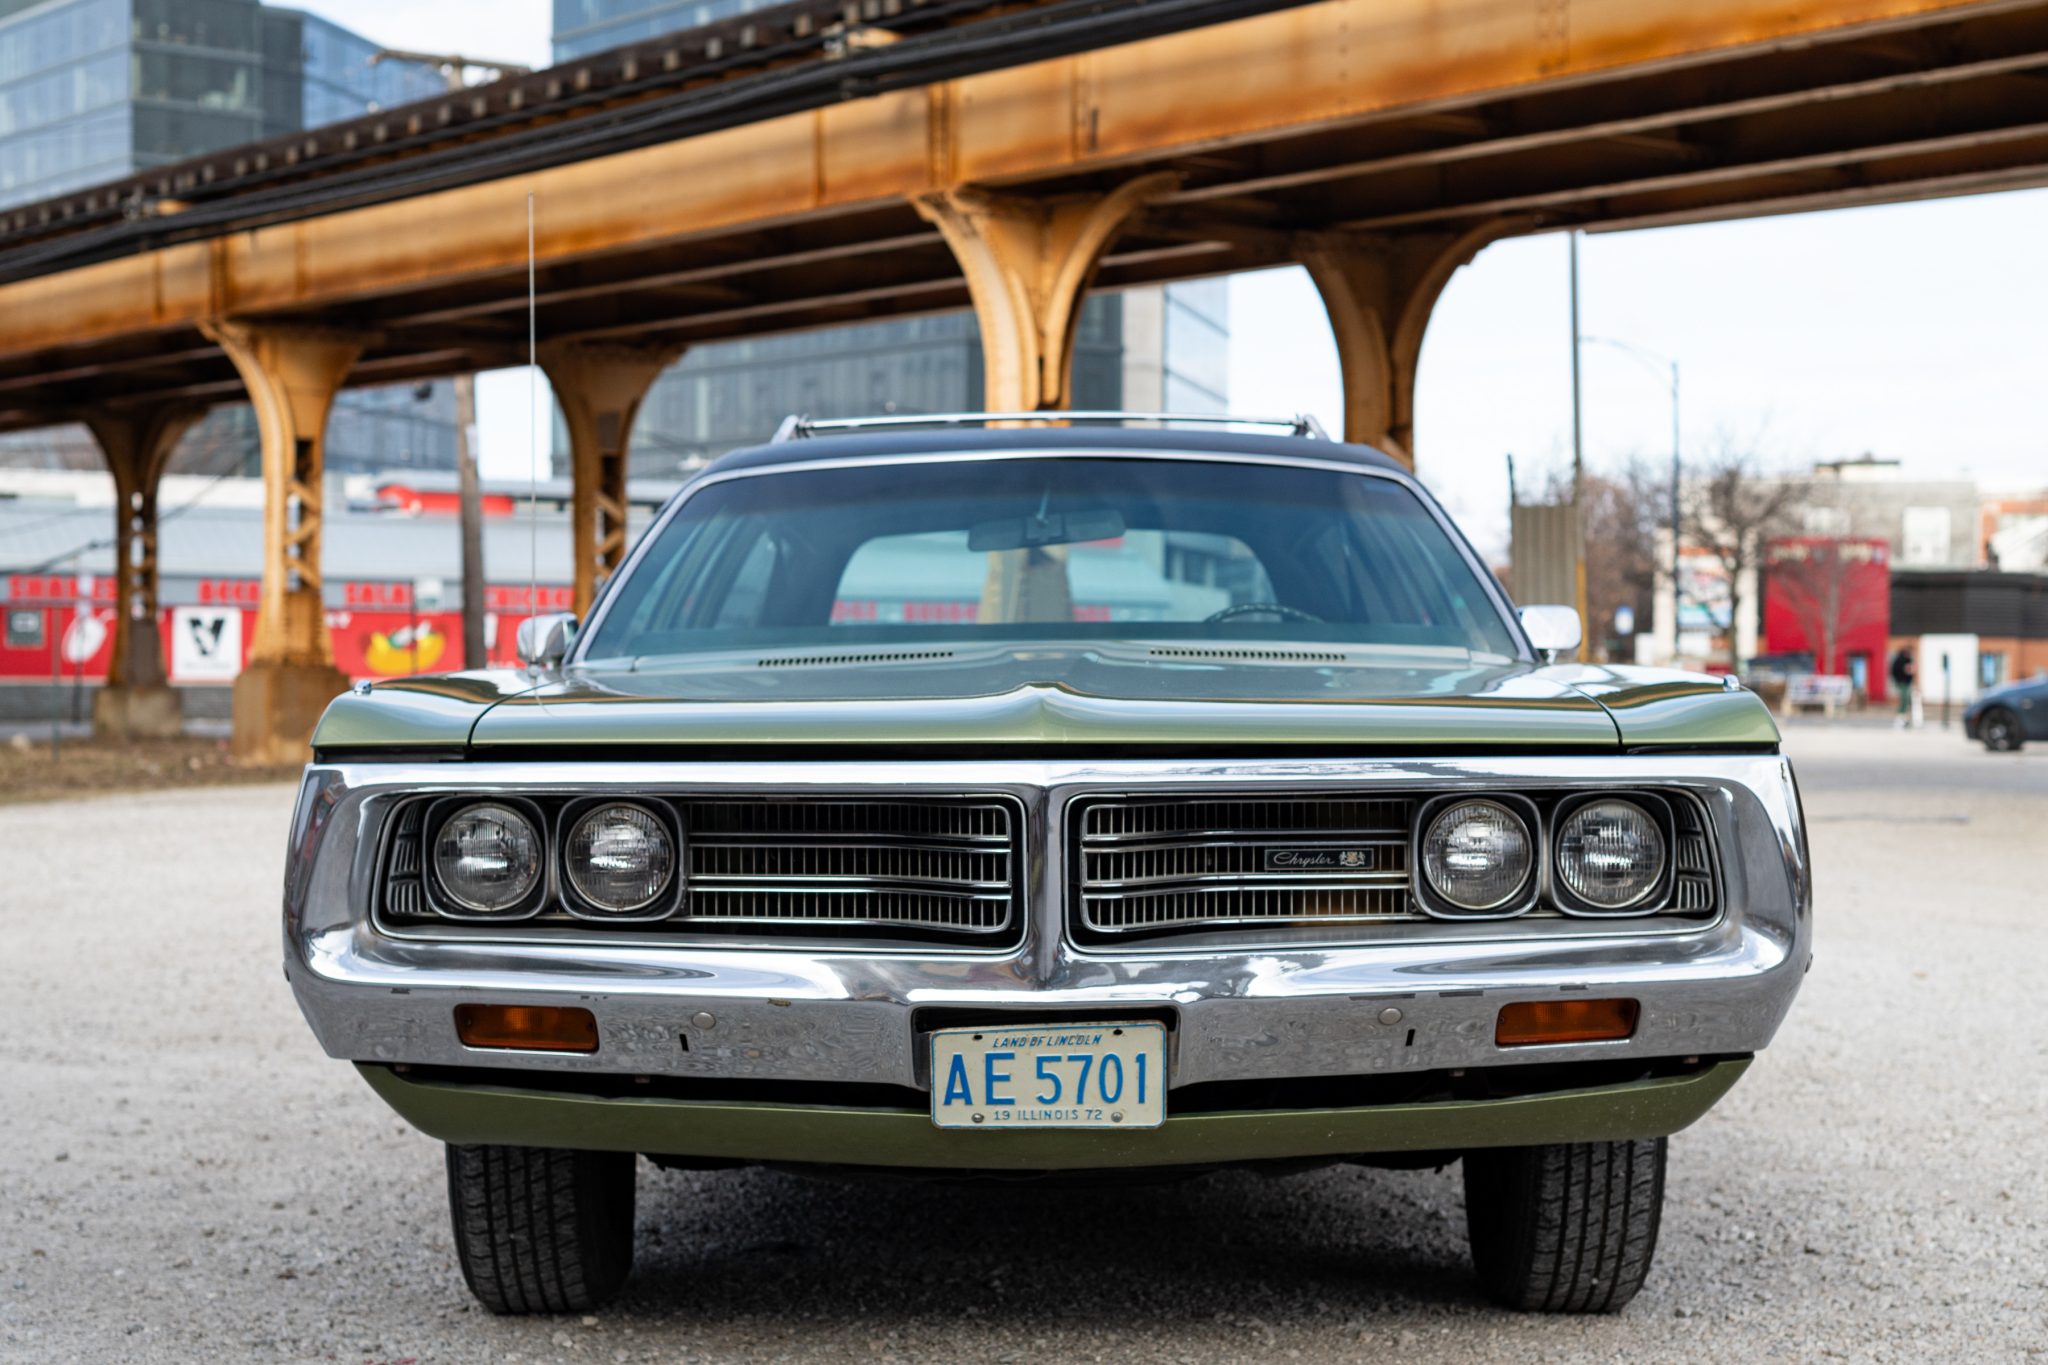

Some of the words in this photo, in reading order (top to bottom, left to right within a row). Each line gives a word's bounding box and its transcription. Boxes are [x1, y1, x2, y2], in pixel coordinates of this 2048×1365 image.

[1273, 851, 1335, 867] Chrysler
[993, 1036, 1027, 1048] LAND
[1029, 1035, 1044, 1047] OF
[1047, 1034, 1102, 1046] LINCOLN
[943, 1052, 1015, 1105] AE
[1036, 1053, 1146, 1105] 5701
[994, 1109, 1010, 1120] 19
[1018, 1109, 1079, 1120] ILLINOIS
[1086, 1109, 1102, 1120] 72
